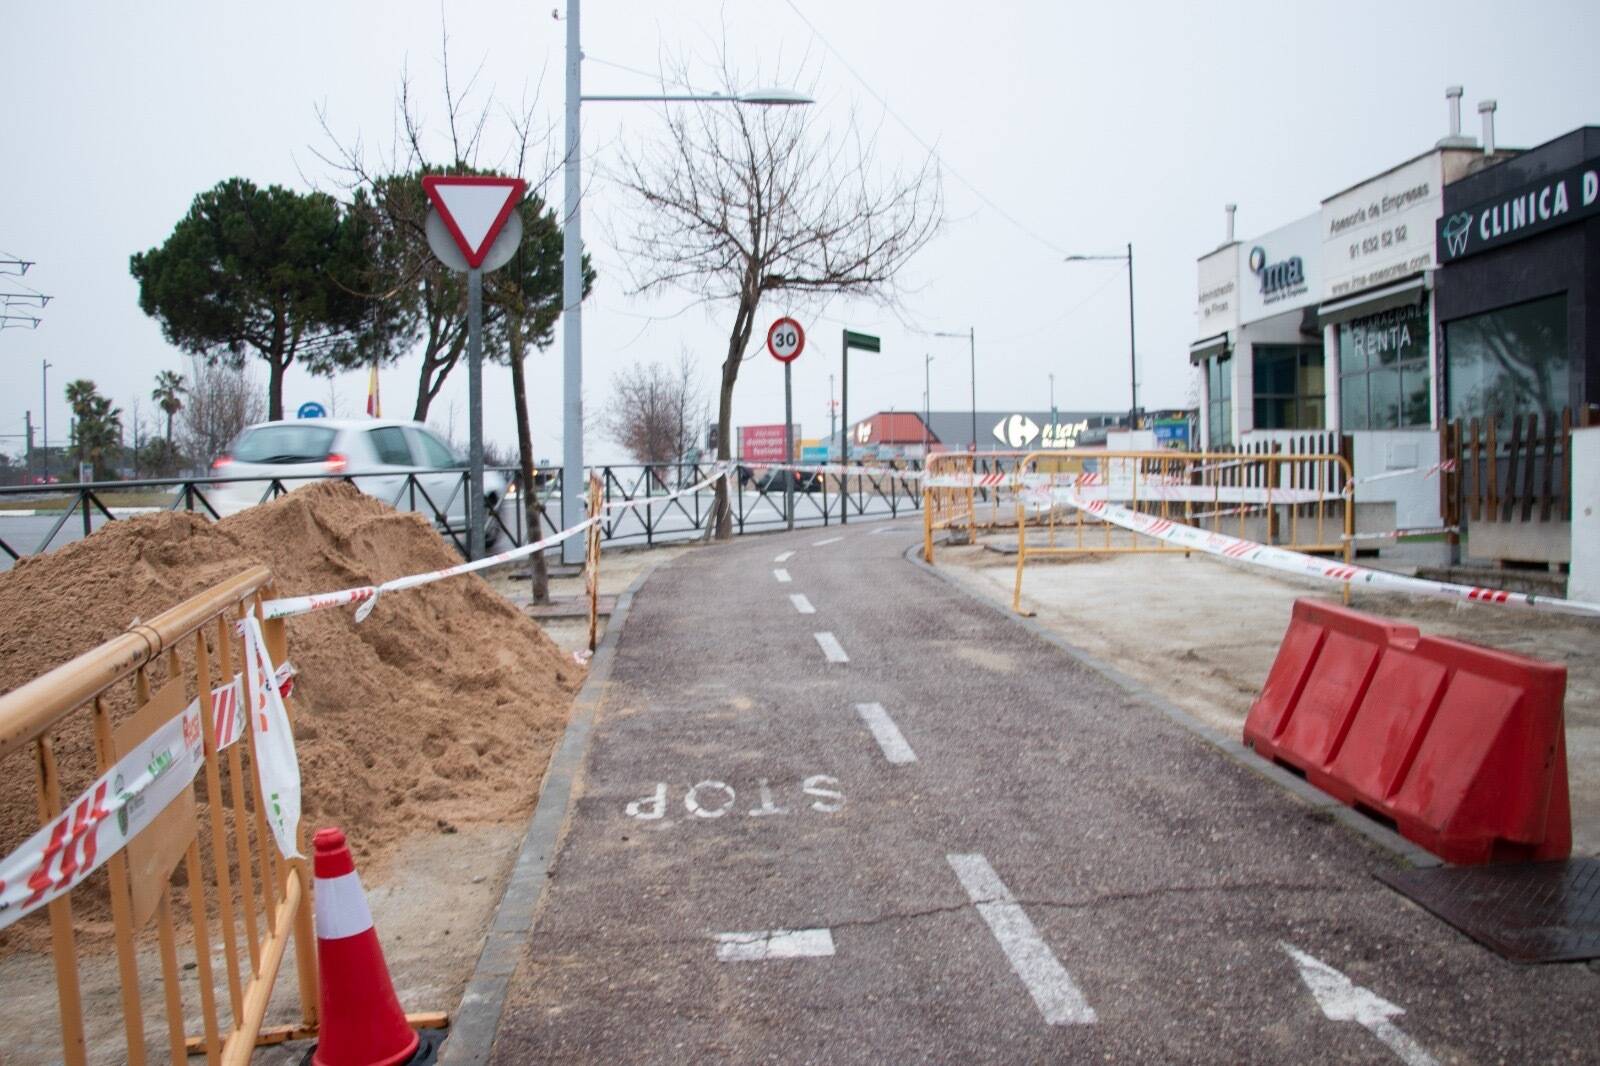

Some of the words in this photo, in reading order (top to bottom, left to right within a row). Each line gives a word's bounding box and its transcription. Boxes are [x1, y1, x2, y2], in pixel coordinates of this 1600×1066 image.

[1382, 183, 1429, 213] Empresas
[1479, 180, 1569, 241] CLINICA
[775, 332, 796, 348] 30
[1354, 323, 1412, 357] RENTA
[625, 774, 847, 820] STOP
